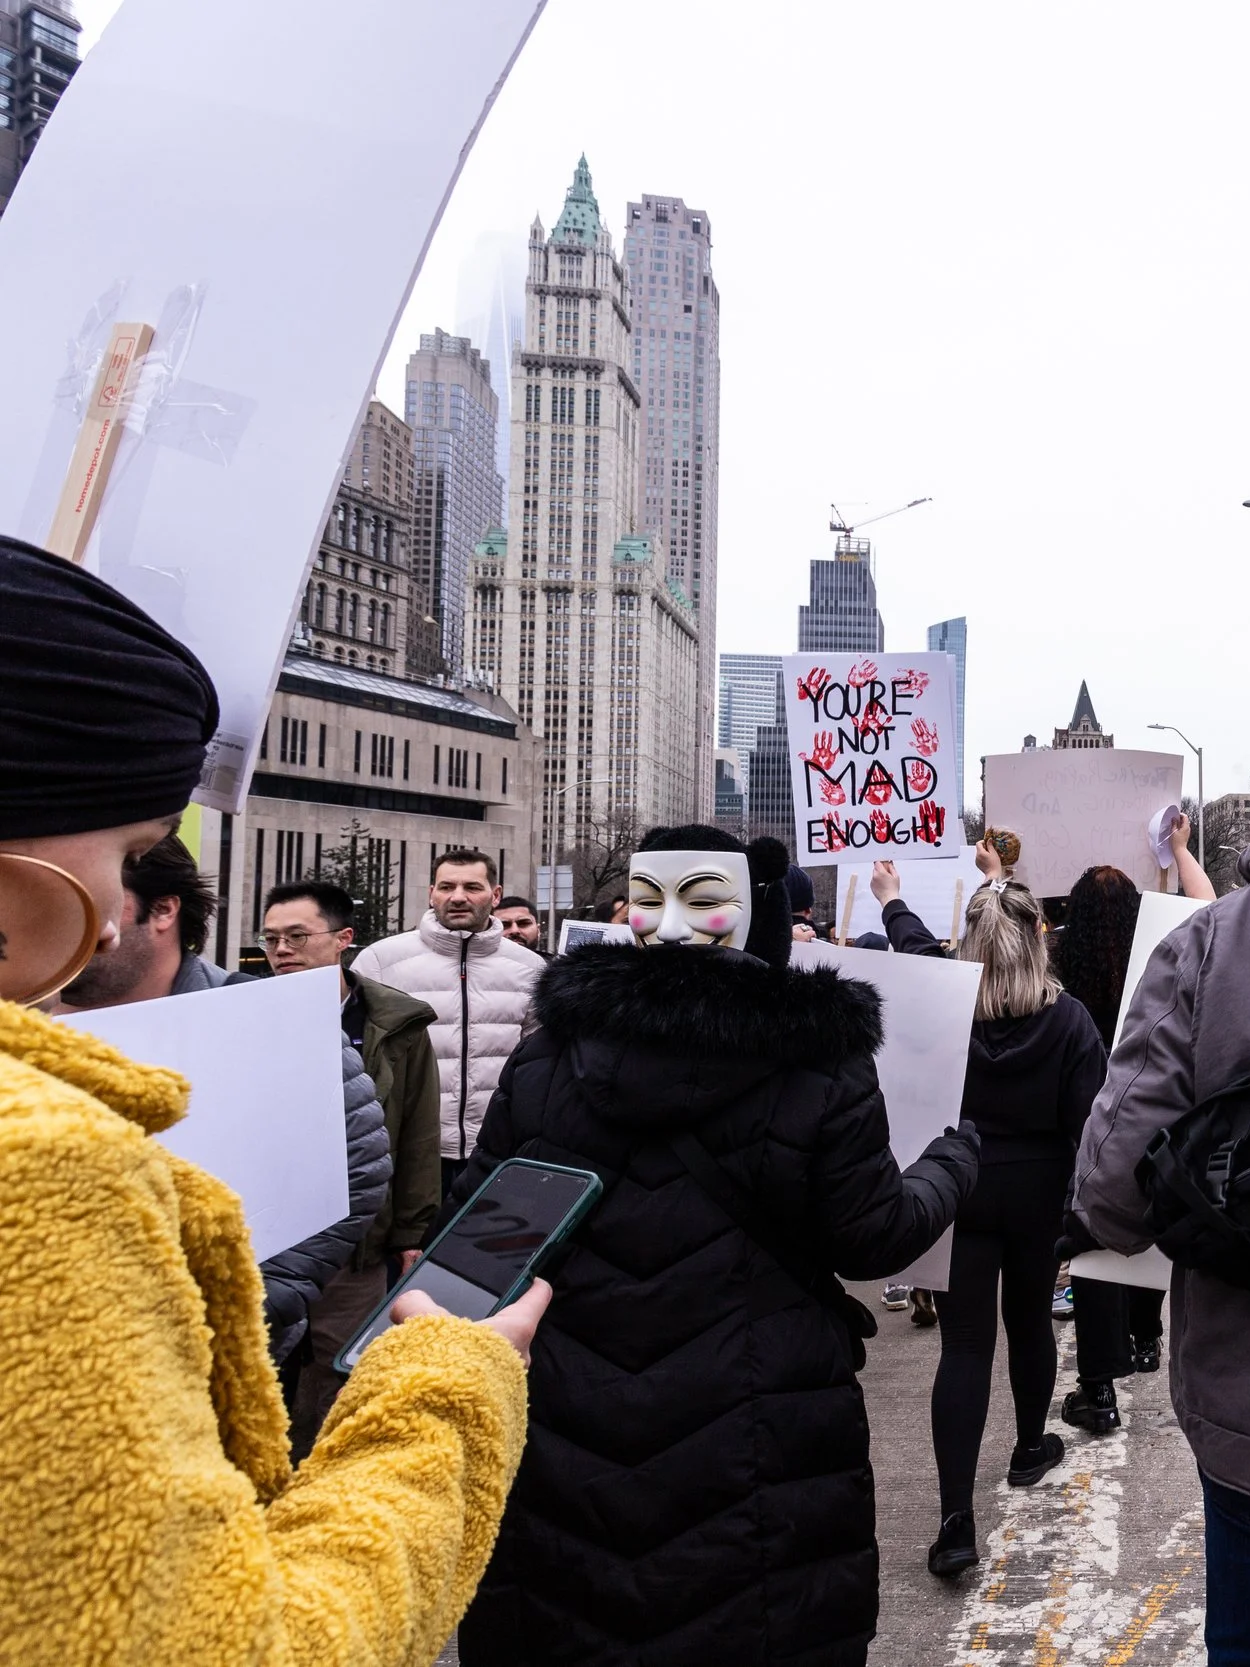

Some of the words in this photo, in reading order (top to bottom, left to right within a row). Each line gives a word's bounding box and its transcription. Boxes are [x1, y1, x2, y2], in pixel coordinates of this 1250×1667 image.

[75, 418, 110, 513] homedepot.com
[838, 726, 896, 755] NOT
[804, 757, 938, 808] MAD
[807, 807, 942, 853] ENOUGH!
